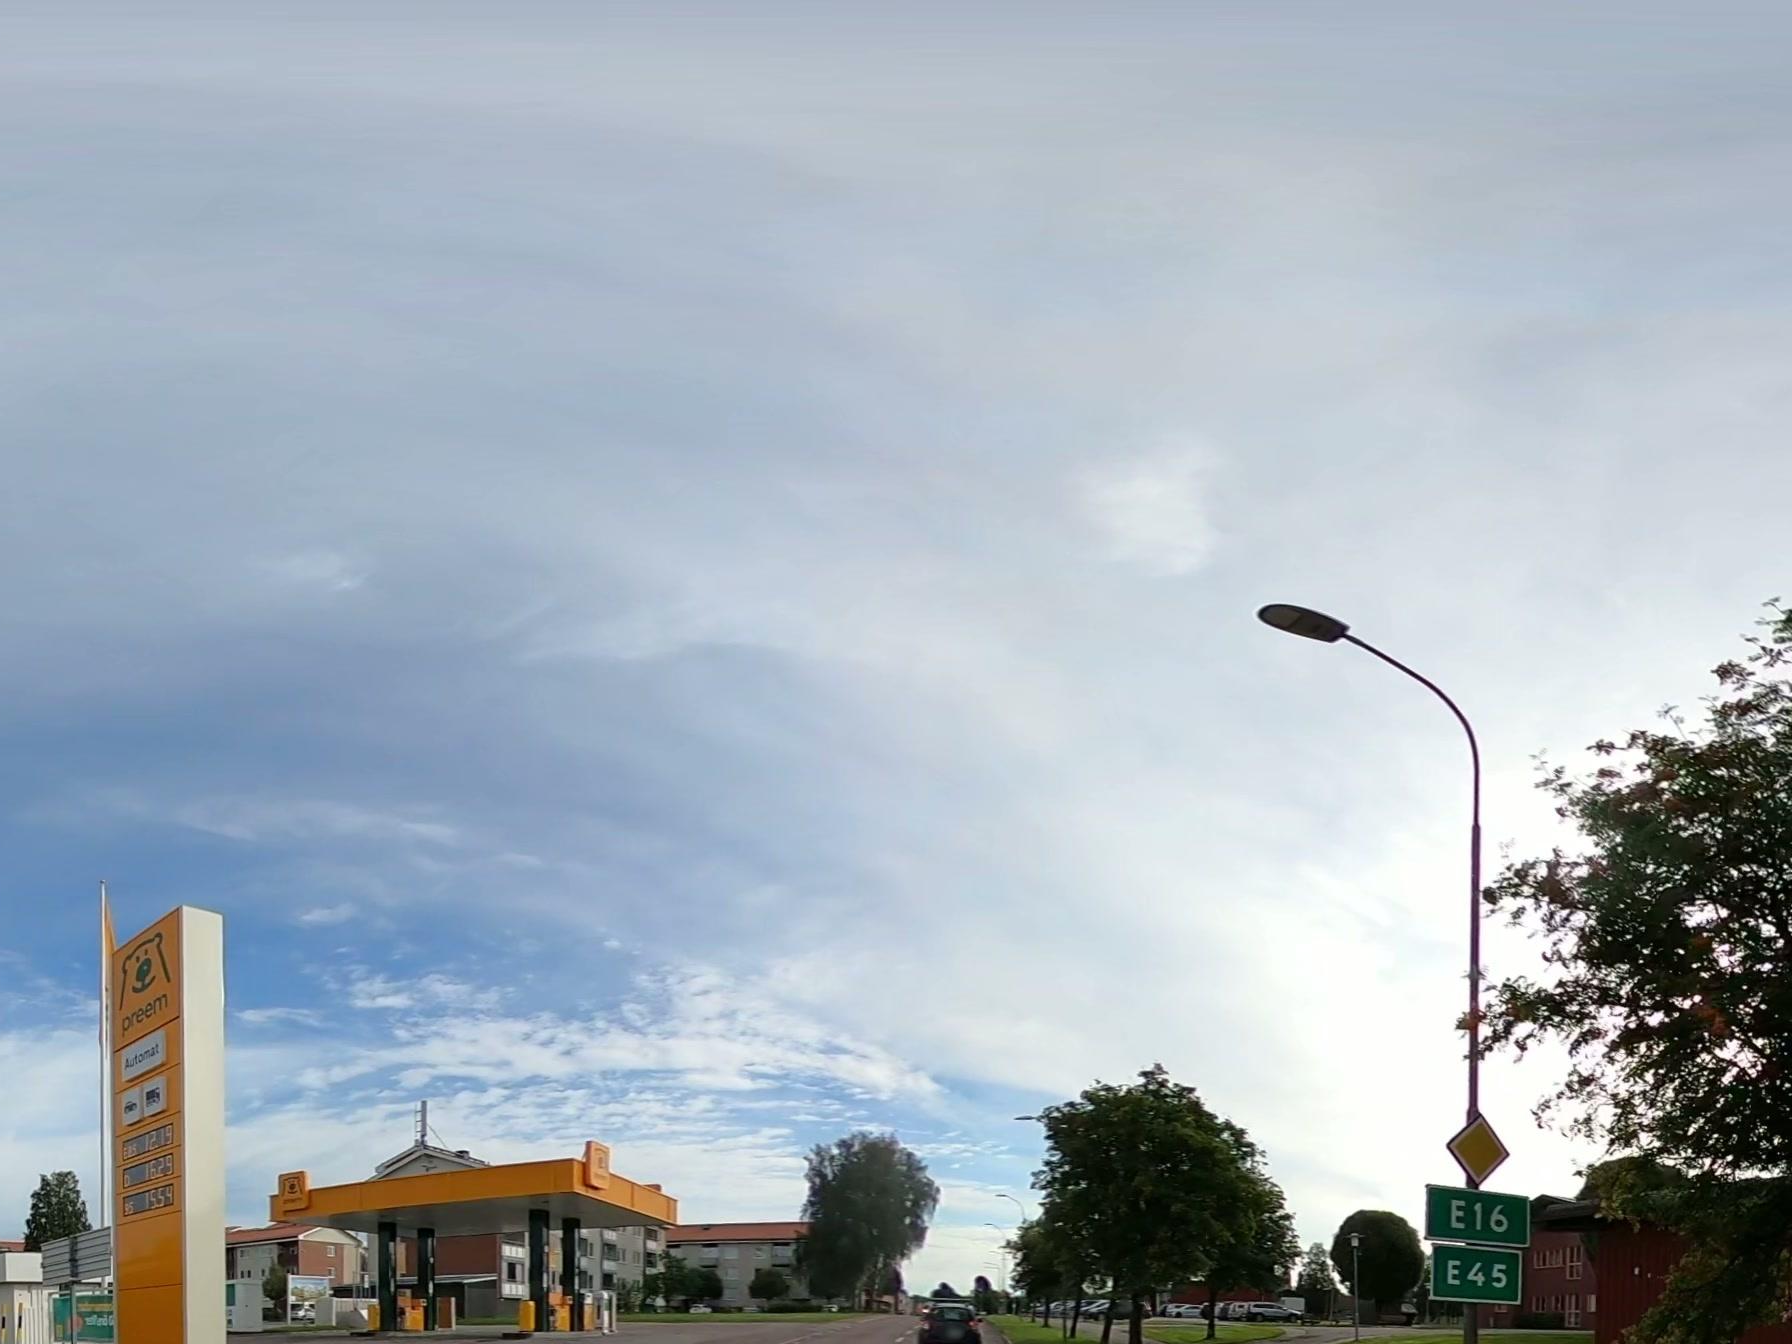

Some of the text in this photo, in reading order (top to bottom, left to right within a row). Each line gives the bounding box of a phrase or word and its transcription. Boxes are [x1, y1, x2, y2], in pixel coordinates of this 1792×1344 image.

[122, 993, 168, 1038] preem
[124, 1043, 160, 1070] Automat
[1450, 1199, 1509, 1233] E16
[1447, 1259, 1508, 1288] E45
